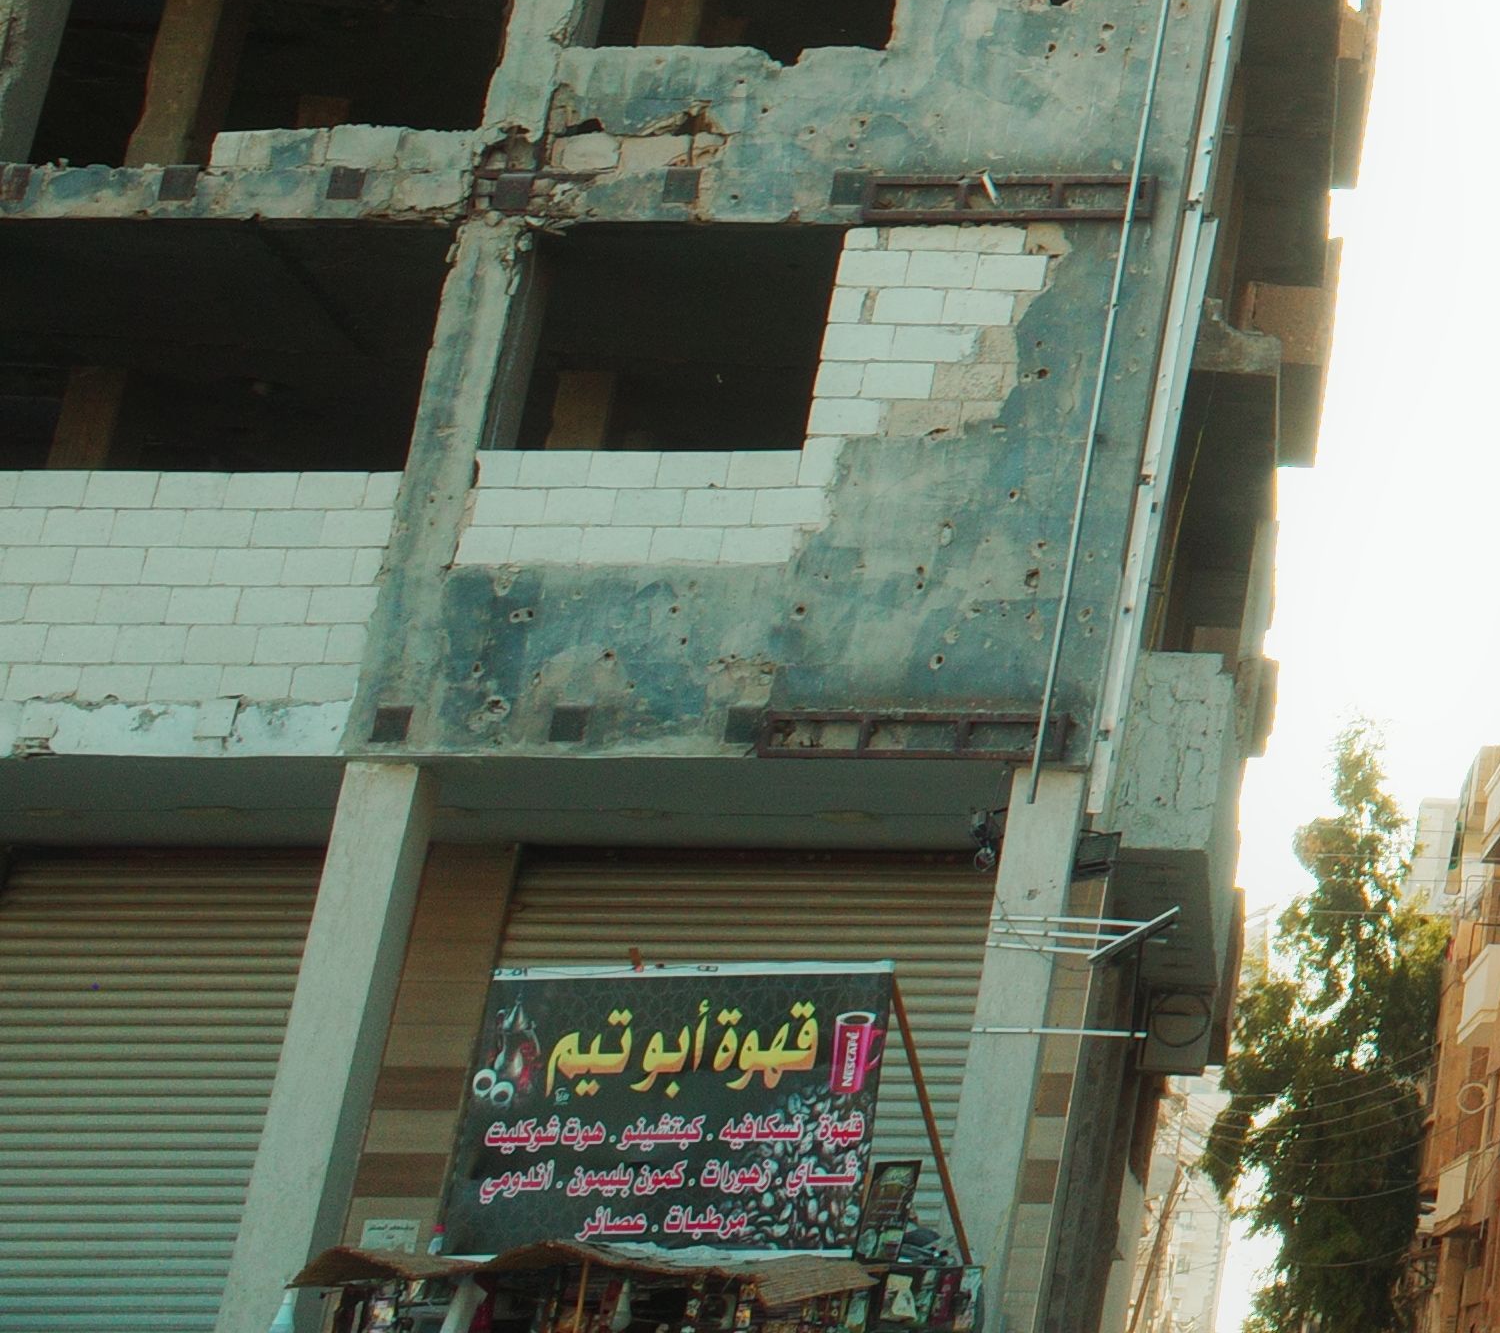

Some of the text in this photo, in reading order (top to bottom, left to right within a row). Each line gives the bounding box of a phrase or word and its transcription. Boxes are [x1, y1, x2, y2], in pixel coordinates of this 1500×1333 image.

[545, 998, 819, 1099] قهوة أبو تيم
[484, 1110, 865, 1154] قهوة نسكافيه كبتشينو هوت شوكليت
[479, 1159, 555, 1204] أندومي
[566, 1162, 634, 1198] بليمون
[633, 1160, 688, 1196] كمون
[701, 1159, 772, 1193] زهورات
[575, 1204, 748, 1241] مرطبات عصائر
